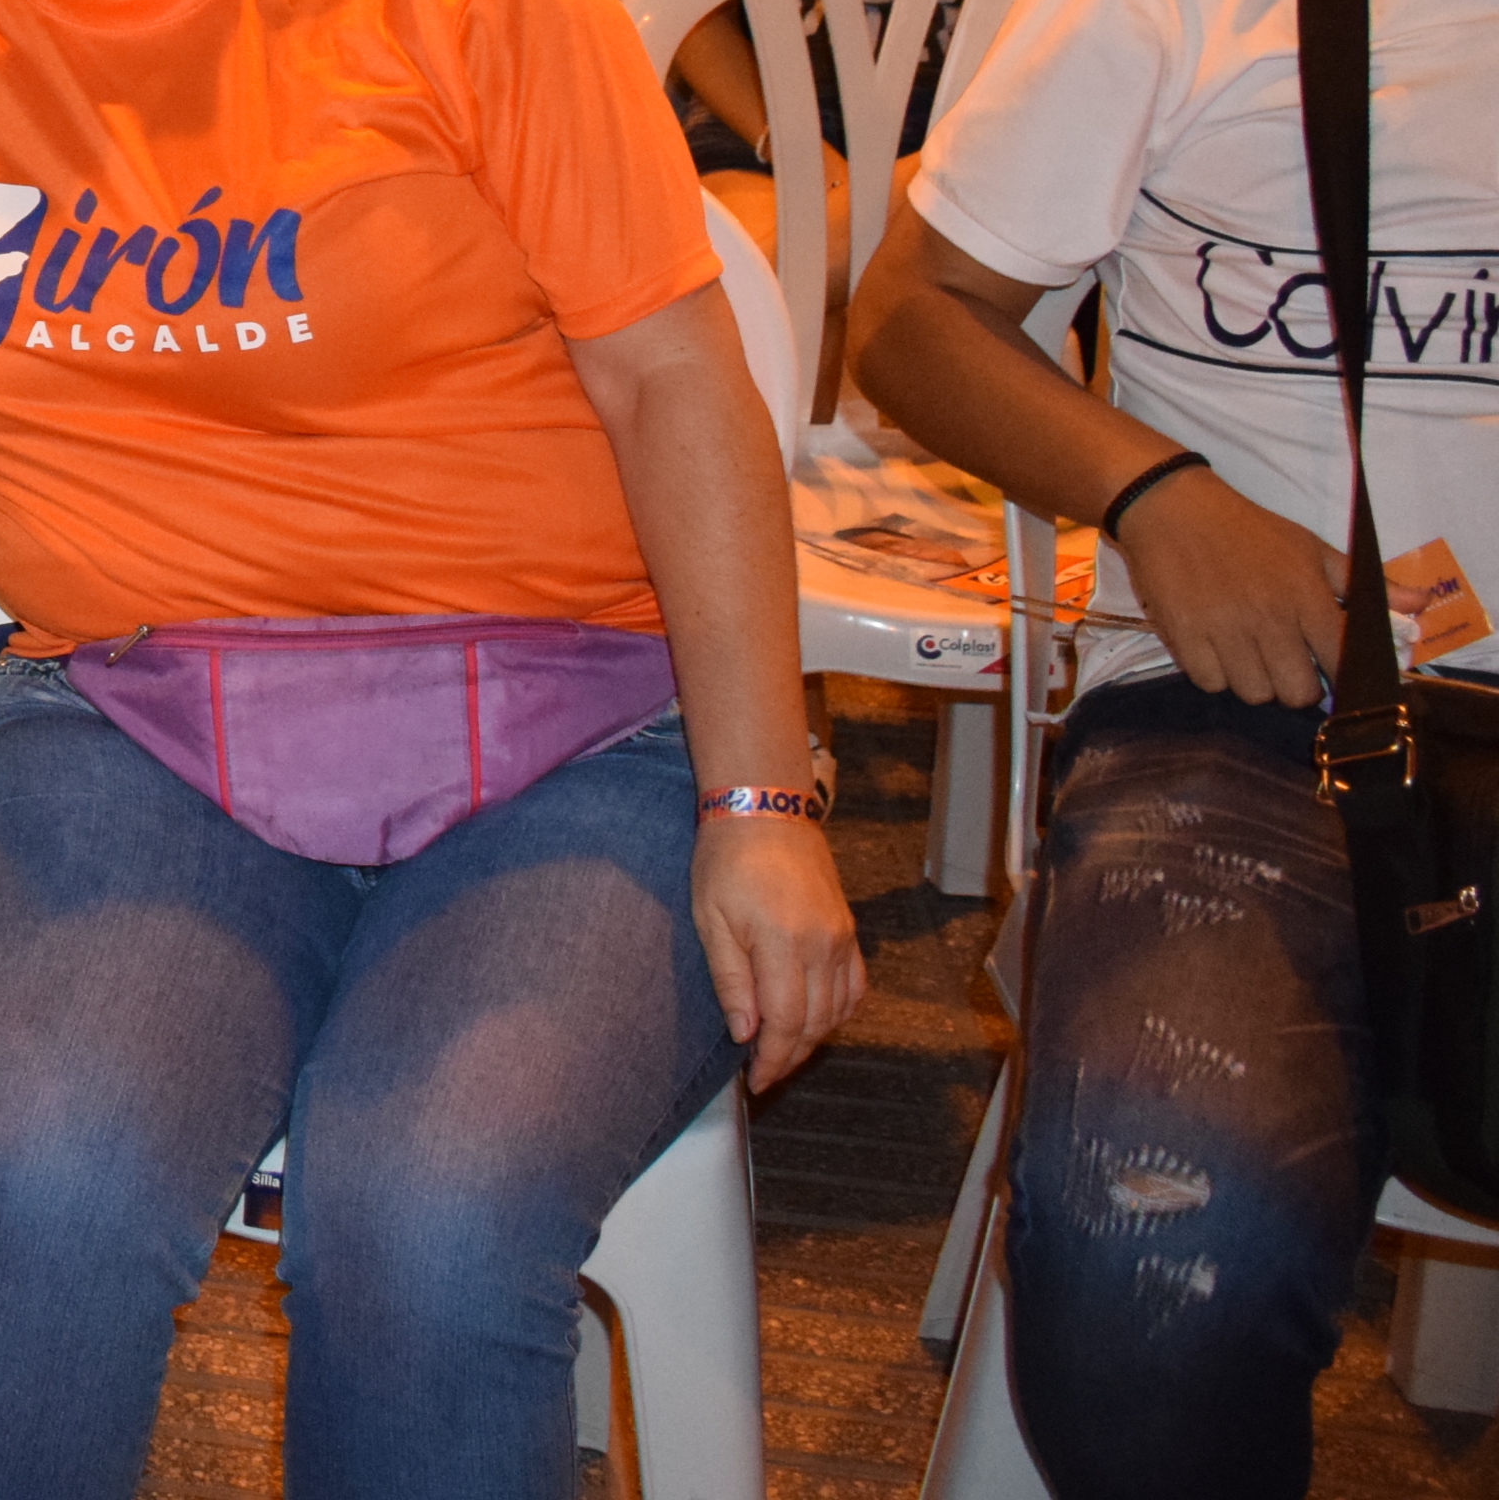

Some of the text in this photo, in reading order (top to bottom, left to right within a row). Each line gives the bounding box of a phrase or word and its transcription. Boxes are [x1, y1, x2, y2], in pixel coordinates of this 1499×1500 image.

[25, 312, 314, 354] ALCALDE
[756, 790, 802, 816] SOY
[251, 1172, 281, 1188] Silla
